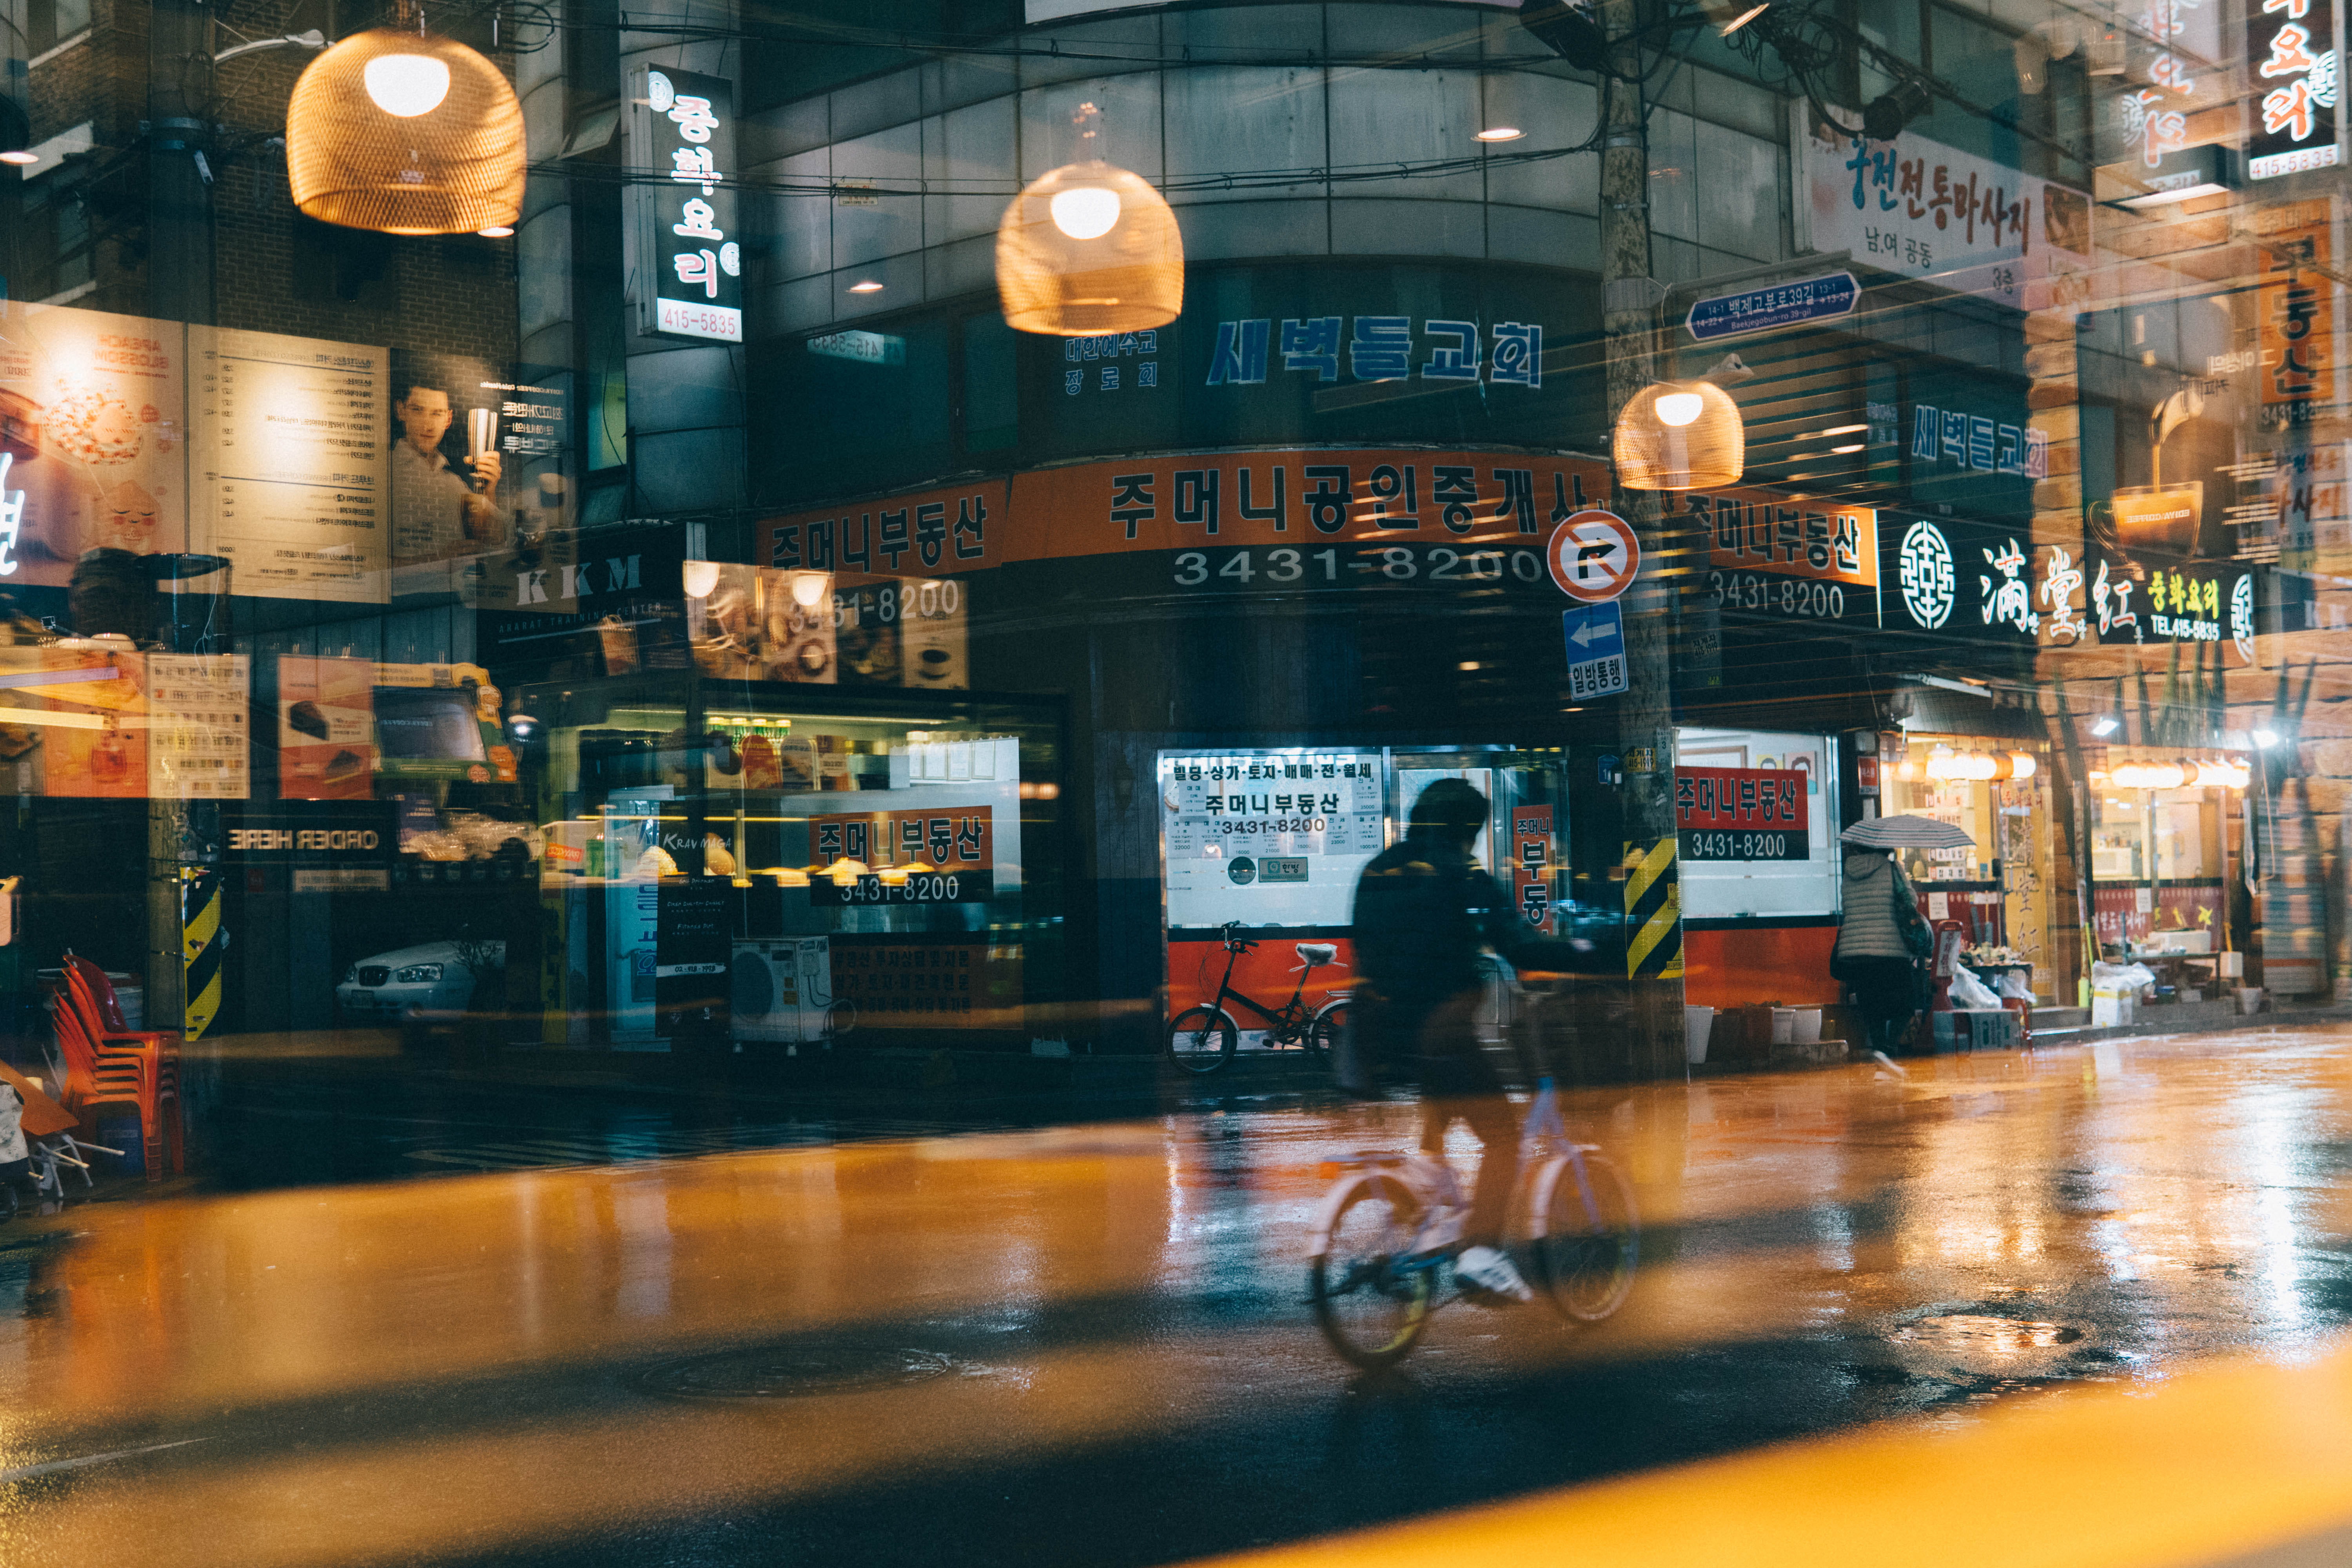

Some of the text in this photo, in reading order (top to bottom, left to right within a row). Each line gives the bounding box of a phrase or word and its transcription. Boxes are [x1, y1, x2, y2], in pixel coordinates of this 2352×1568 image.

[2260, 0, 2319, 141] 요리
[2251, 149, 2335, 178] 415-5835
[668, 94, 723, 298] 중화요리
[1728, 283, 1815, 319] 백제고분로39길
[1819, 284, 1836, 294] 13-1
[665, 308, 735, 335] 415-5835
[1731, 313, 1789, 330] Baekjegobun-ro
[1065, 330, 1157, 362] 대한예수교
[1206, 316, 1543, 389] 새벽들교회
[1911, 404, 2049, 483] 새벽들교회
[772, 494, 987, 577] 주머니부동산
[1685, 492, 1861, 575] 주머니부동산
[1174, 548, 1543, 584] 3431-8200
[788, 579, 959, 633] 3431-8200
[1710, 571, 1845, 619] 3431-8200
[2147, 570, 2220, 619] 중화요리
[550, 610, 608, 626] TRAINING
[616, 602, 662, 618] CENTER
[2151, 614, 2220, 641] TEL.415-5835
[1572, 657, 1622, 695] 일방통행
[1662, 741, 1666, 749] 3
[1205, 793, 1339, 816] 주머니부동산
[1677, 777, 1795, 821] 주머니부동산
[818, 816, 983, 866] 주머니부동산
[1222, 818, 1325, 835] 3431-8200
[1517, 817, 1550, 838] 주머니
[1693, 833, 1785, 857] 3431-8200
[1282, 863, 1299, 874] 한방
[841, 875, 959, 902] 3431-8200
[1521, 840, 1549, 936] 부동
